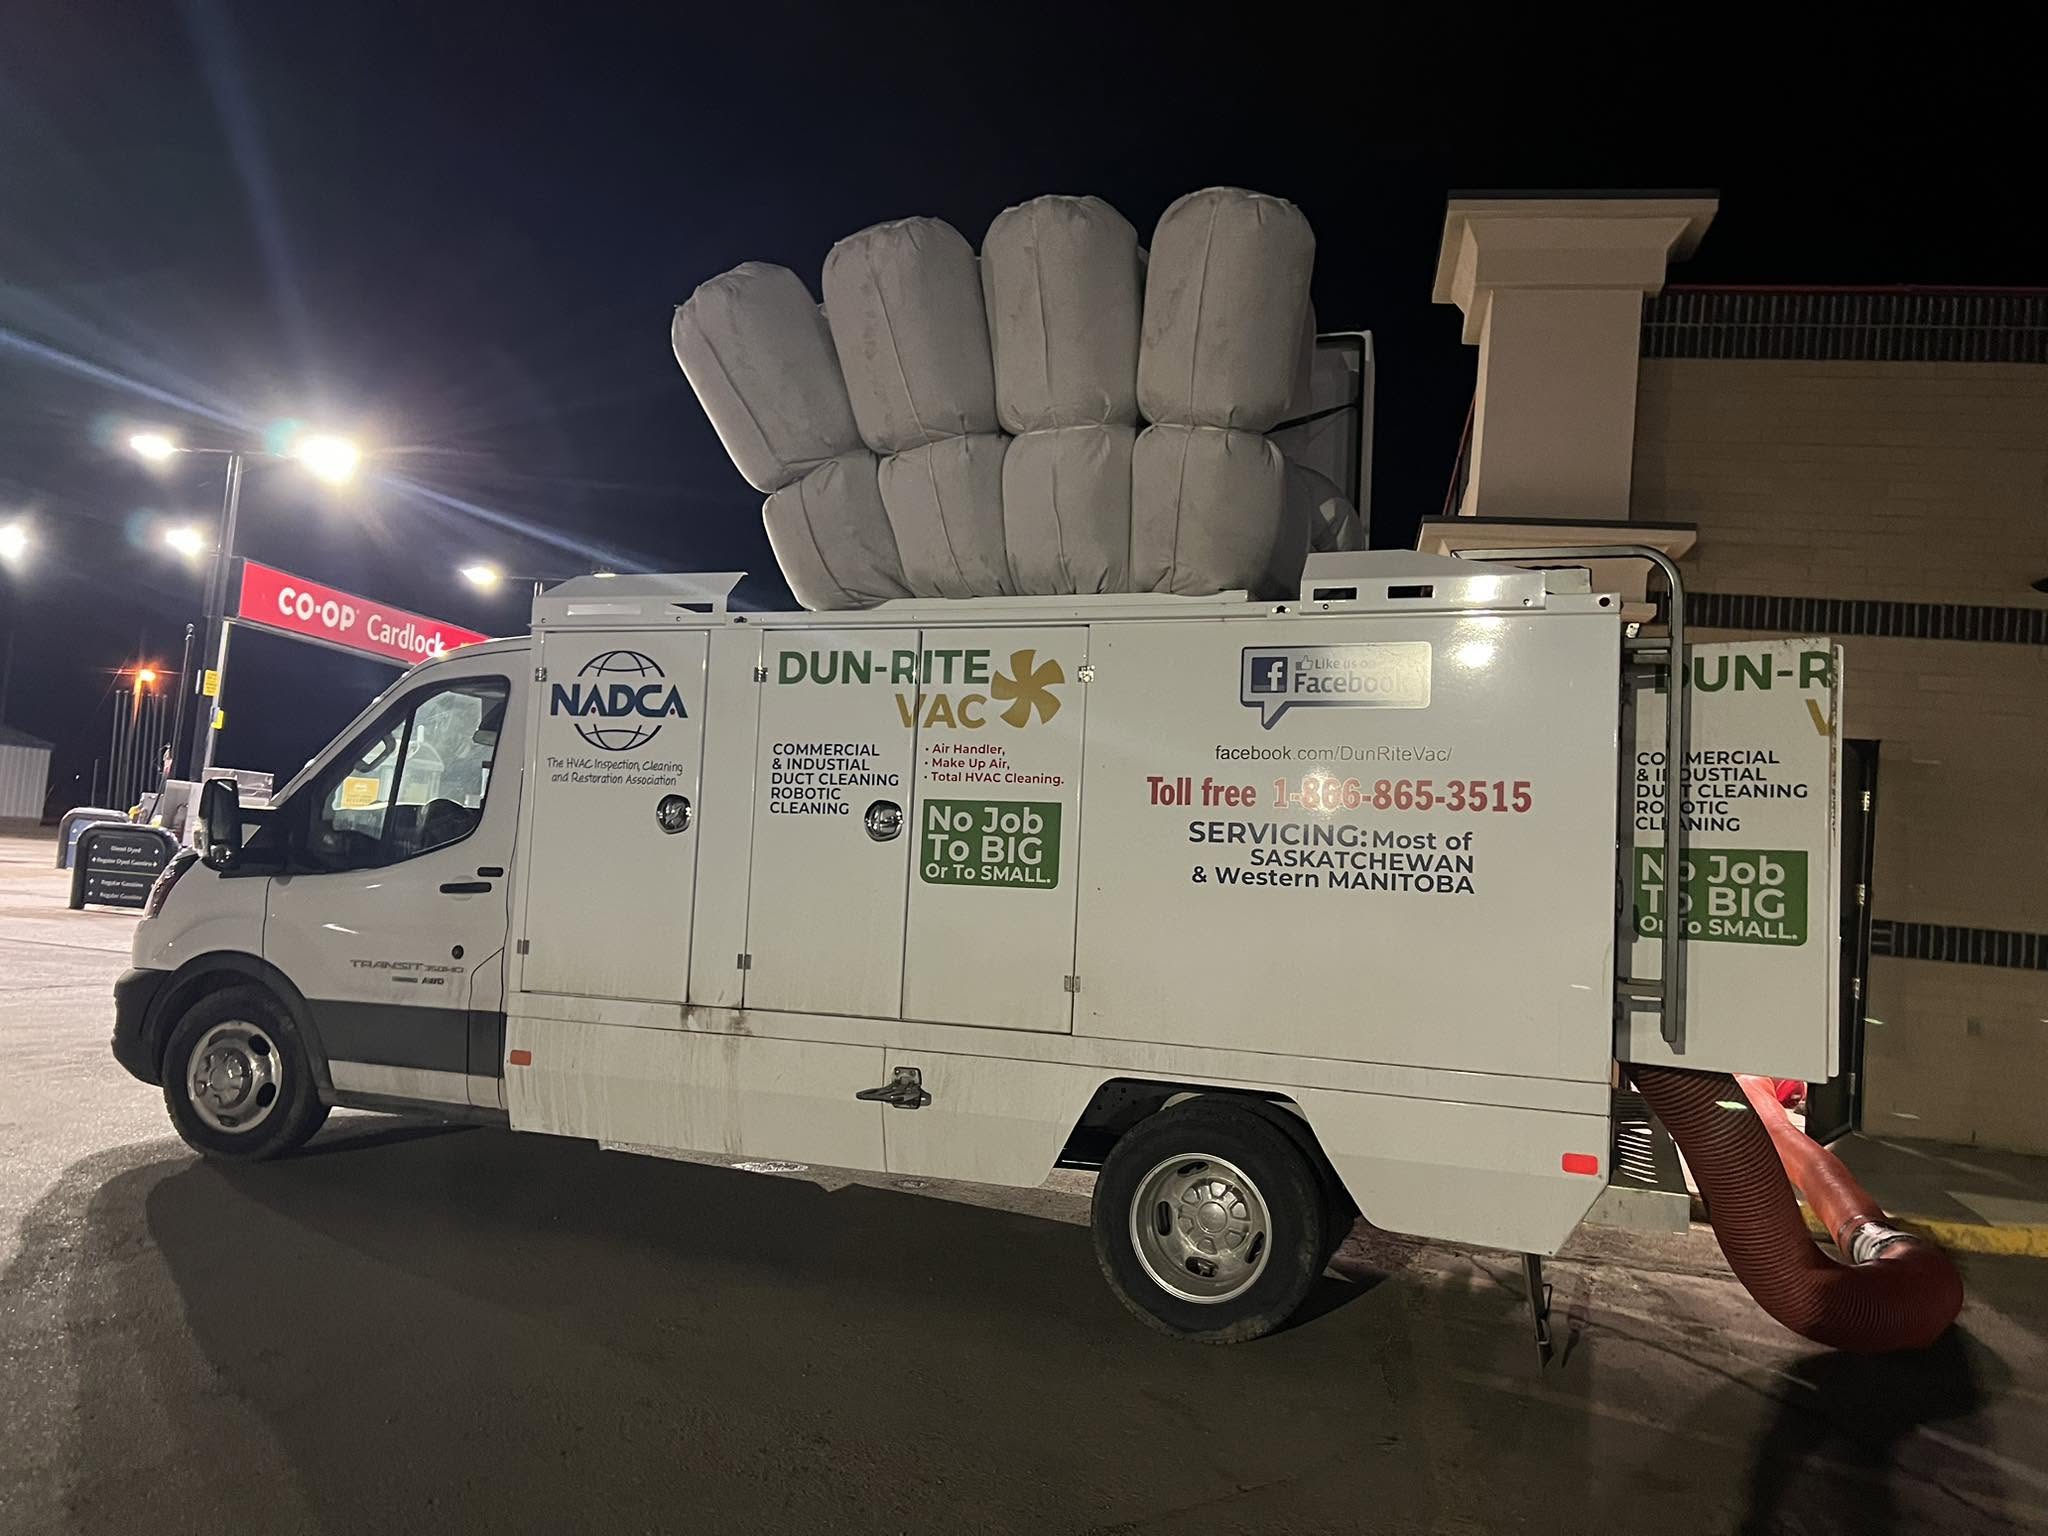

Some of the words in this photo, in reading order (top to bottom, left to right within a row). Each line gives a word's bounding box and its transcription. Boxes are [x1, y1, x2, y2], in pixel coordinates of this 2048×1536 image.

[367, 614, 446, 658] Cardlock
[778, 649, 990, 685] DUN-RITE
[1316, 658, 1339, 670] Like
[1294, 672, 1408, 694] Faceboo
[550, 683, 688, 718] NADCA
[895, 693, 988, 729] VAC
[772, 743, 880, 757] COMMERCIAL
[932, 744, 951, 754] Air
[953, 744, 1006, 757] Handler,
[1215, 744, 1453, 763] facebook.com/DunRiteVac/
[1636, 750, 1780, 766] COMERCIAL
[547, 757, 564, 768] The
[566, 758, 595, 769] HVAC
[594, 759, 640, 773] Inspection,
[642, 761, 683, 776] Cleaning
[772, 758, 782, 770] &
[787, 758, 870, 771] INDUSTIAL
[932, 758, 966, 768] Make
[969, 759, 986, 771] Up
[989, 759, 1010, 771] Air,
[552, 772, 568, 782] and
[571, 772, 623, 784] Restoration
[626, 775, 677, 786] Association
[771, 772, 816, 785] DUCT
[818, 773, 899, 787] CLEANING
[931, 772, 962, 782] Total
[965, 772, 1001, 783] HVAC
[1004, 773, 1064, 786] Cleaning.
[1637, 768, 1649, 782] &
[1656, 767, 1767, 782] IDUSTIAL
[771, 787, 841, 800] ROBOTIC
[1147, 776, 1192, 806] Toll
[1201, 777, 1257, 807] free
[1272, 776, 1533, 814] 1-866-865-3515
[1636, 784, 1692, 799] DUT
[1697, 784, 1808, 799] CLEANING
[769, 802, 850, 815] CLEANING
[1636, 801, 1729, 816] ROOTIC
[928, 805, 973, 832] No
[981, 807, 1043, 835] Job
[1188, 821, 1368, 848] SERVICING:
[1373, 830, 1437, 851] Most
[1446, 831, 1473, 851] of
[927, 834, 970, 862] To
[981, 836, 1042, 865] BIG
[1250, 848, 1474, 873] SASKATCHEWAN
[925, 863, 948, 879] Or
[953, 864, 975, 880] To
[981, 866, 1050, 884] SMALL.
[1192, 866, 1208, 884] &
[1216, 867, 1319, 888] Western
[1329, 870, 1475, 894] MANITOBA
[1707, 855, 1785, 886] Job
[1708, 886, 1785, 919] BIG
[1709, 919, 1798, 940] SMALL.
[349, 959, 424, 971] TRANSIT
